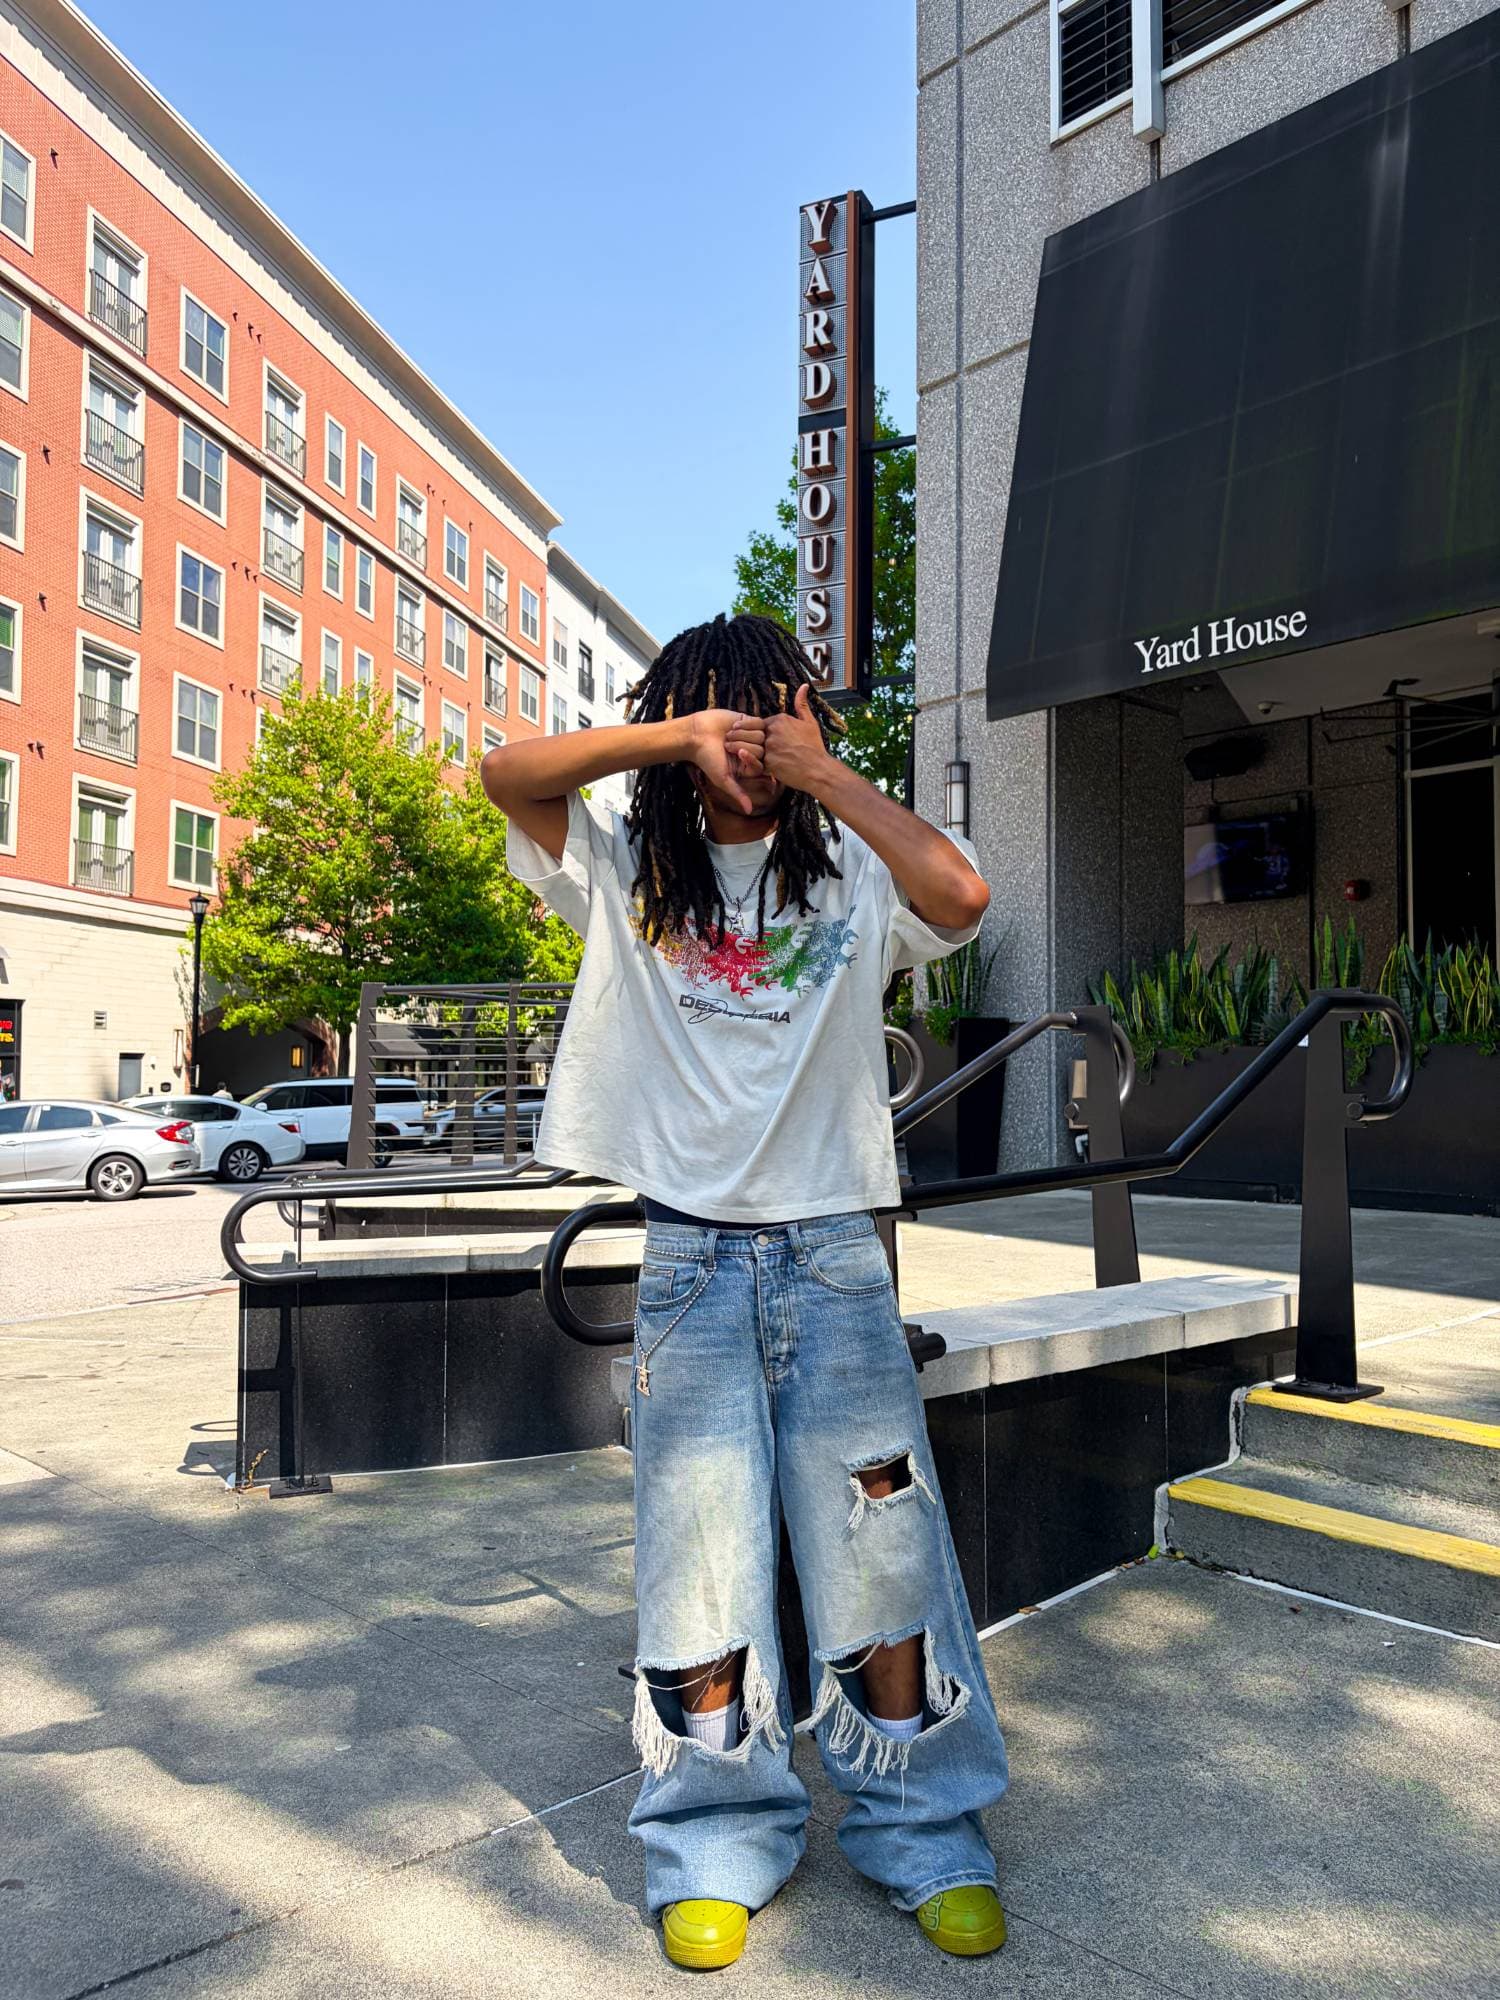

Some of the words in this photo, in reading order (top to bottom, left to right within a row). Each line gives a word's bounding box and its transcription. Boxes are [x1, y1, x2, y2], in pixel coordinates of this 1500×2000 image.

[802, 200, 836, 406] YARD
[1134, 625, 1202, 673] Yard
[1208, 610, 1308, 657] House
